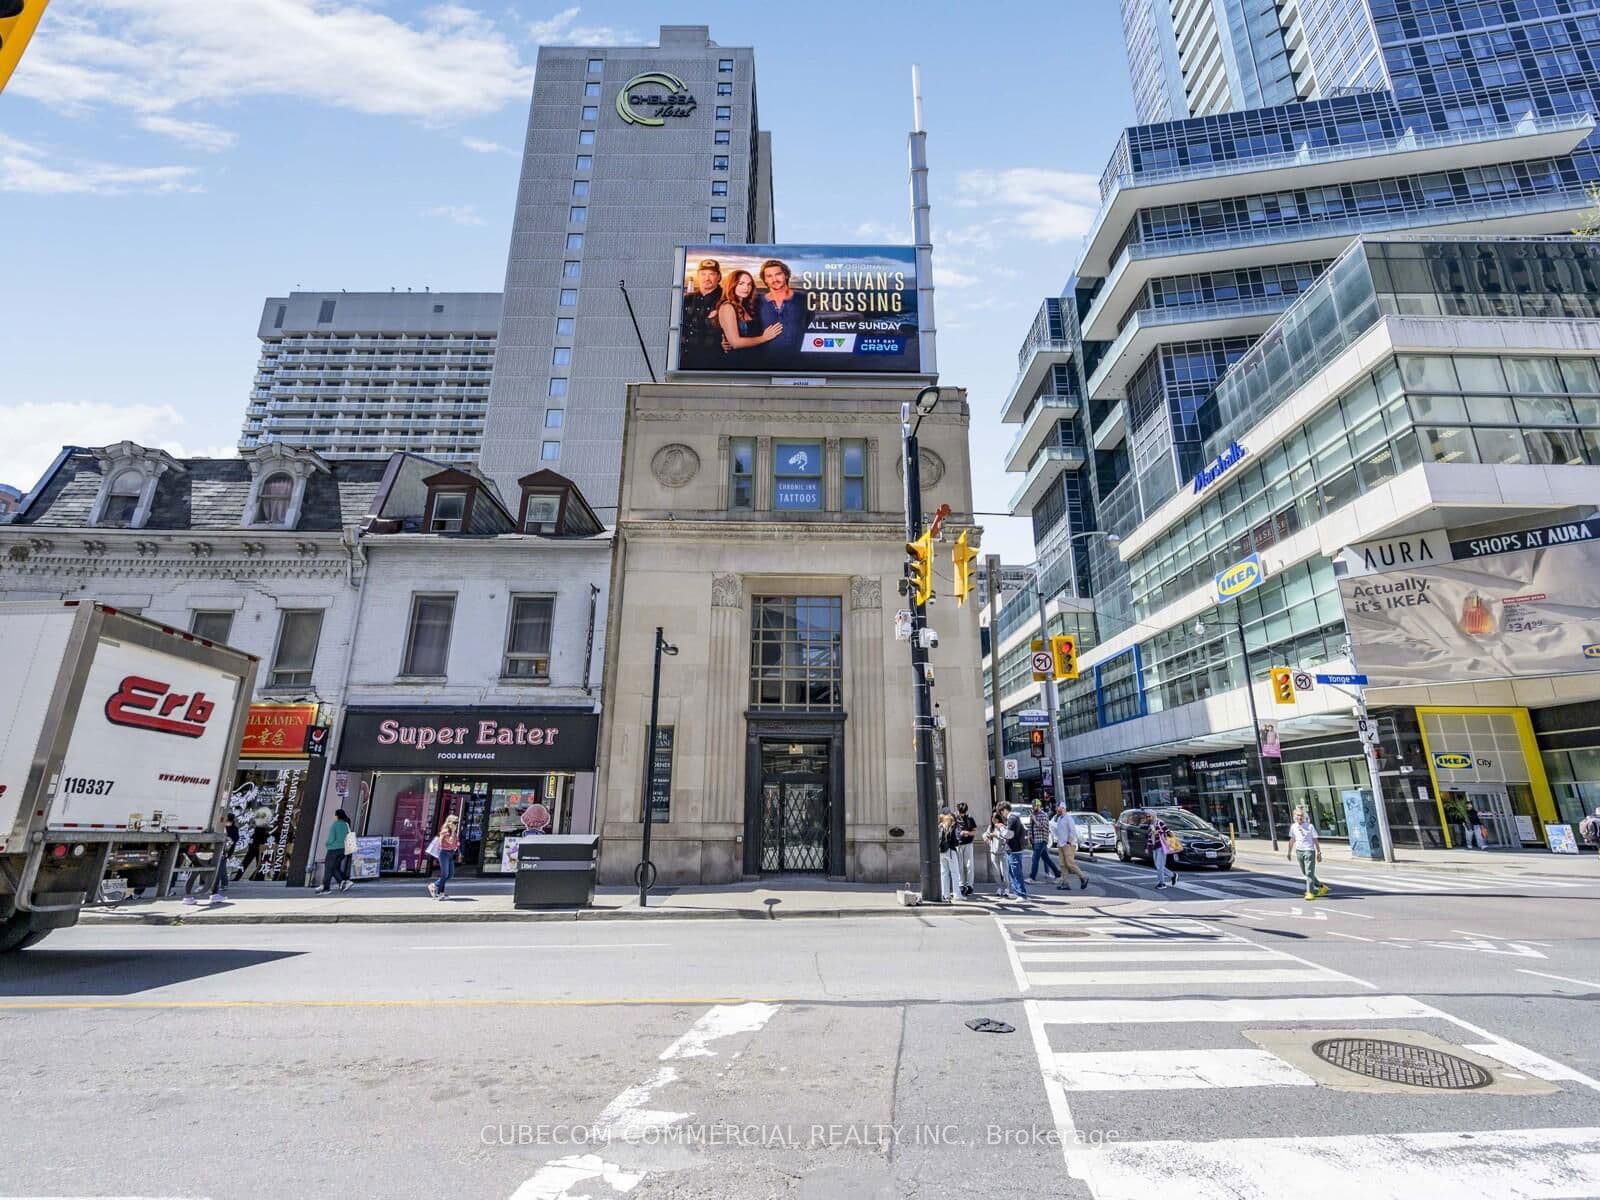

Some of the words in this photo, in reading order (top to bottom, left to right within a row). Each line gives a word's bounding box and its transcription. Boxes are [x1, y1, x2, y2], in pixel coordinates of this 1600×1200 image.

[630, 95, 697, 105] CHELSEA
[803, 271, 904, 291] SULLIVAN'S
[807, 292, 902, 312] CROSSING
[807, 321, 828, 330] ALL
[831, 321, 856, 330] NEW
[858, 321, 902, 331] SUNDAY
[1193, 441, 1246, 494] Marshalls
[779, 493, 817, 503] TATTOOS
[1469, 533, 1522, 557] SHOPS
[1526, 530, 1544, 547] AT
[1548, 523, 1593, 544] AURA
[1364, 538, 1434, 569] AURA
[1220, 564, 1257, 592] IKEA
[1353, 576, 1431, 599] Actually,
[1355, 600, 1382, 613] it's
[1387, 592, 1431, 609] IKEA
[1328, 674, 1351, 685] Yonge
[104, 675, 216, 738] Erb
[263, 715, 304, 726] RAMEN
[377, 719, 469, 750] Super
[476, 720, 559, 745] Eater
[437, 752, 457, 760] FOOD
[462, 752, 496, 760] BEVERAGE
[1438, 757, 1469, 765] IKEA
[1476, 758, 1492, 768] City
[64, 777, 115, 796] 119337
[287, 769, 300, 802] RAMEN
